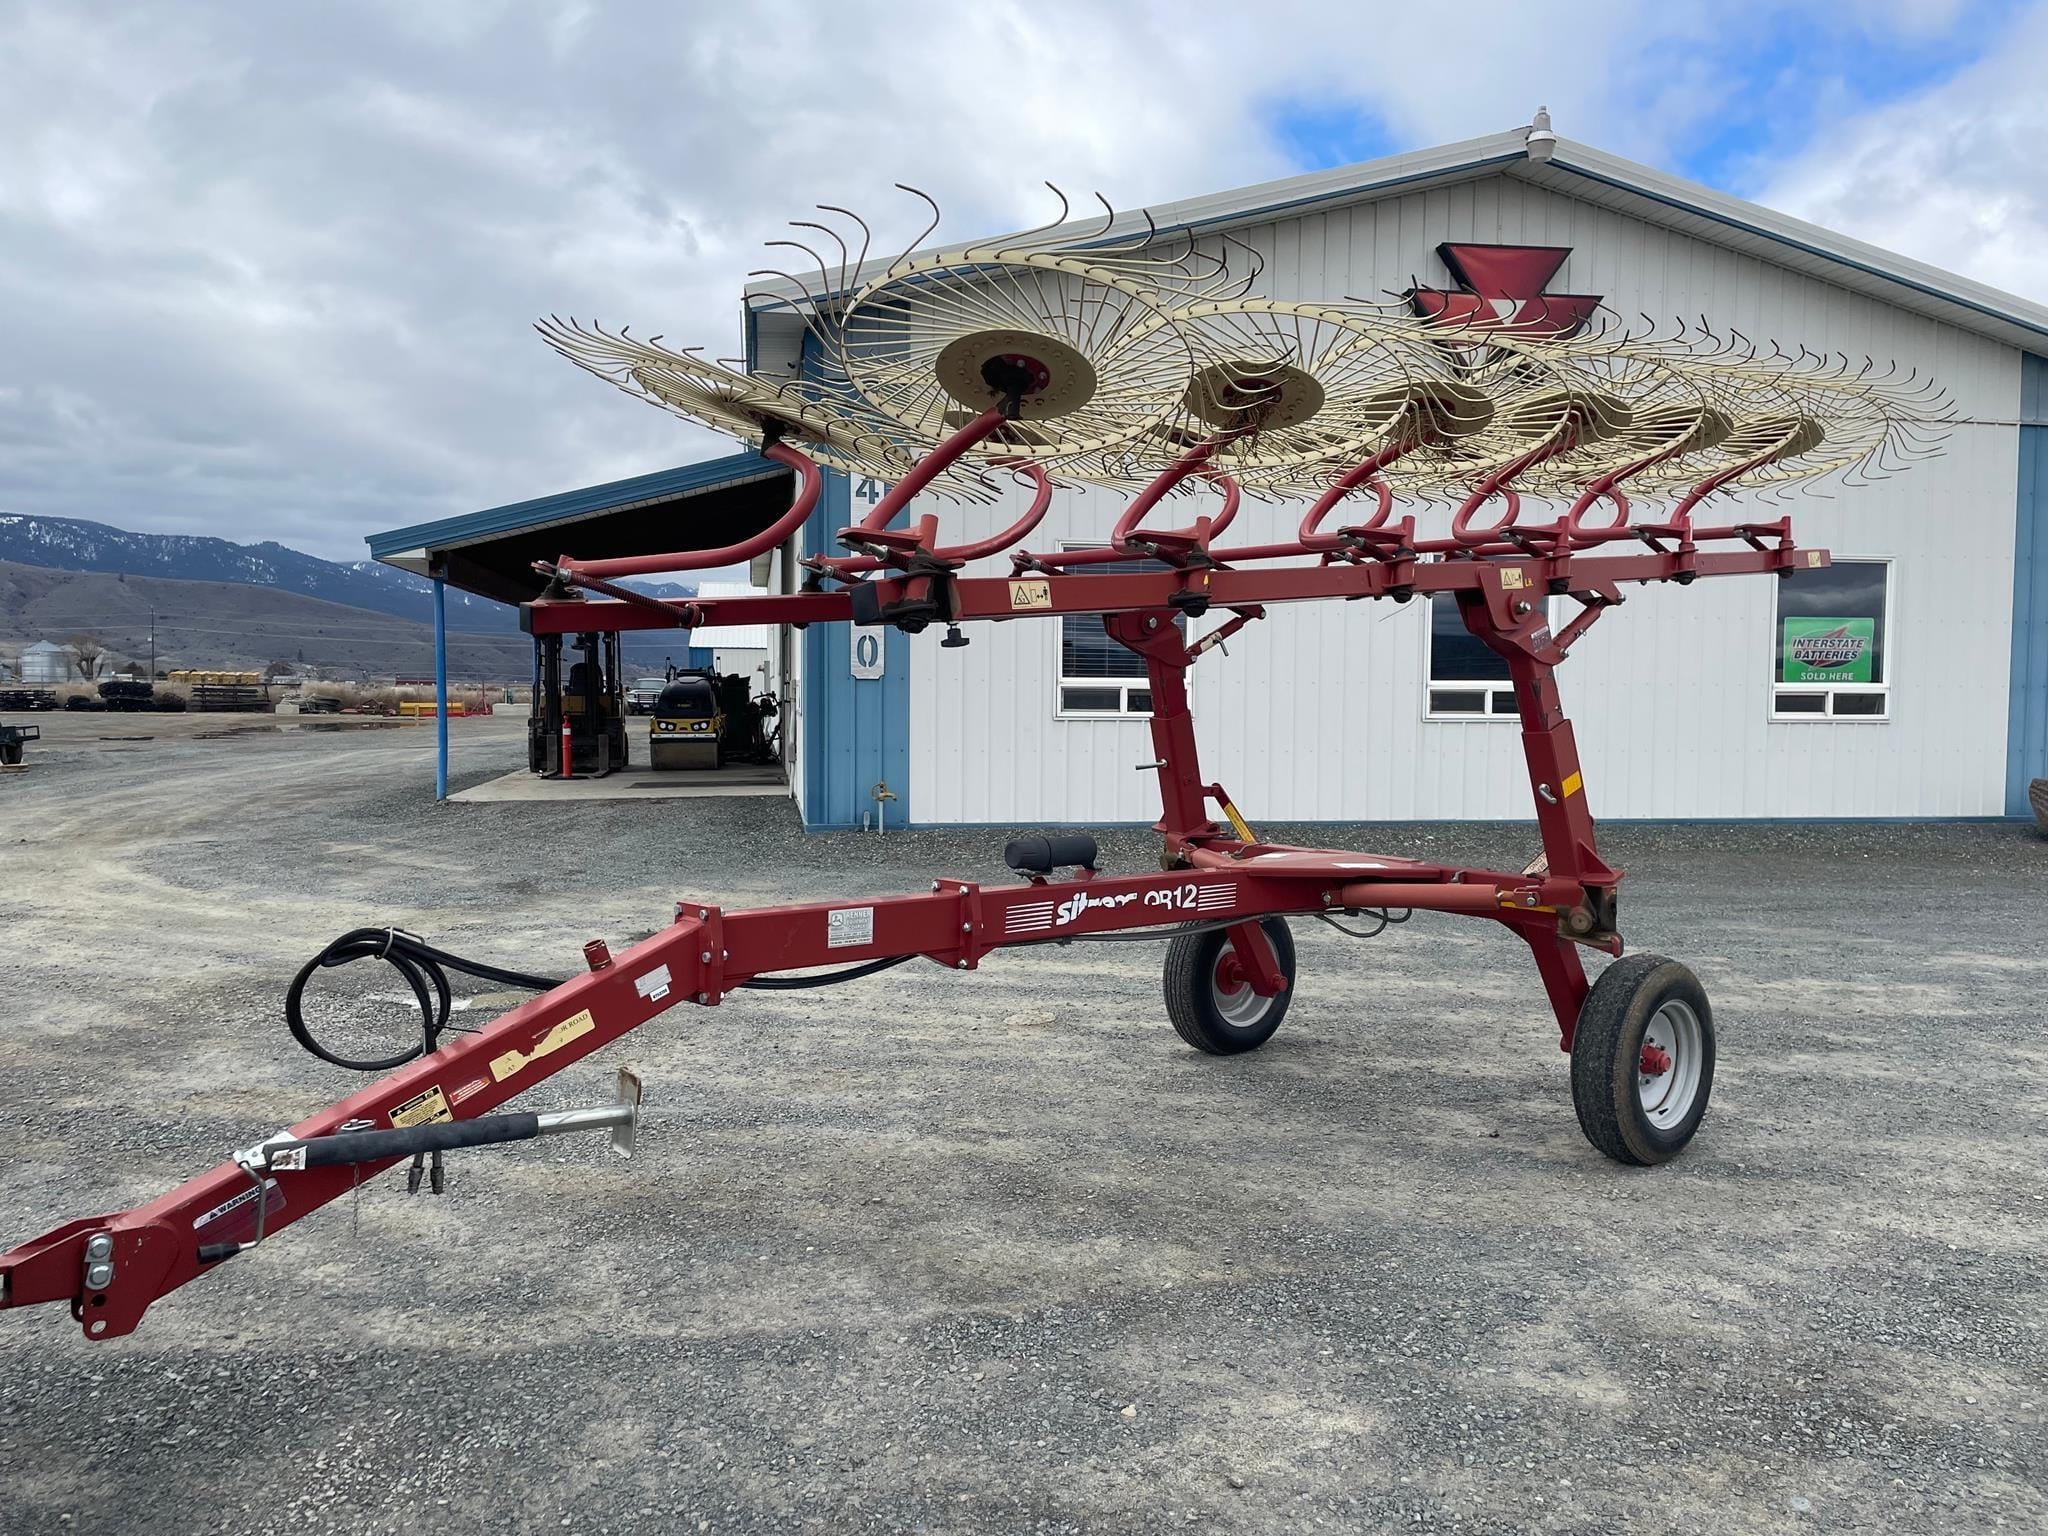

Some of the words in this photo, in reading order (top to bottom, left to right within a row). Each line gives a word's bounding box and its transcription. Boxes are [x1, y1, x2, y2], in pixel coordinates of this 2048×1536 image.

[1792, 639, 1864, 649] INTERSTATE
[1794, 650, 1858, 660] BATTERIES
[1800, 672, 1826, 680] SOLD
[1829, 672, 1854, 681] HERE
[568, 1013, 588, 1027] ROAD
